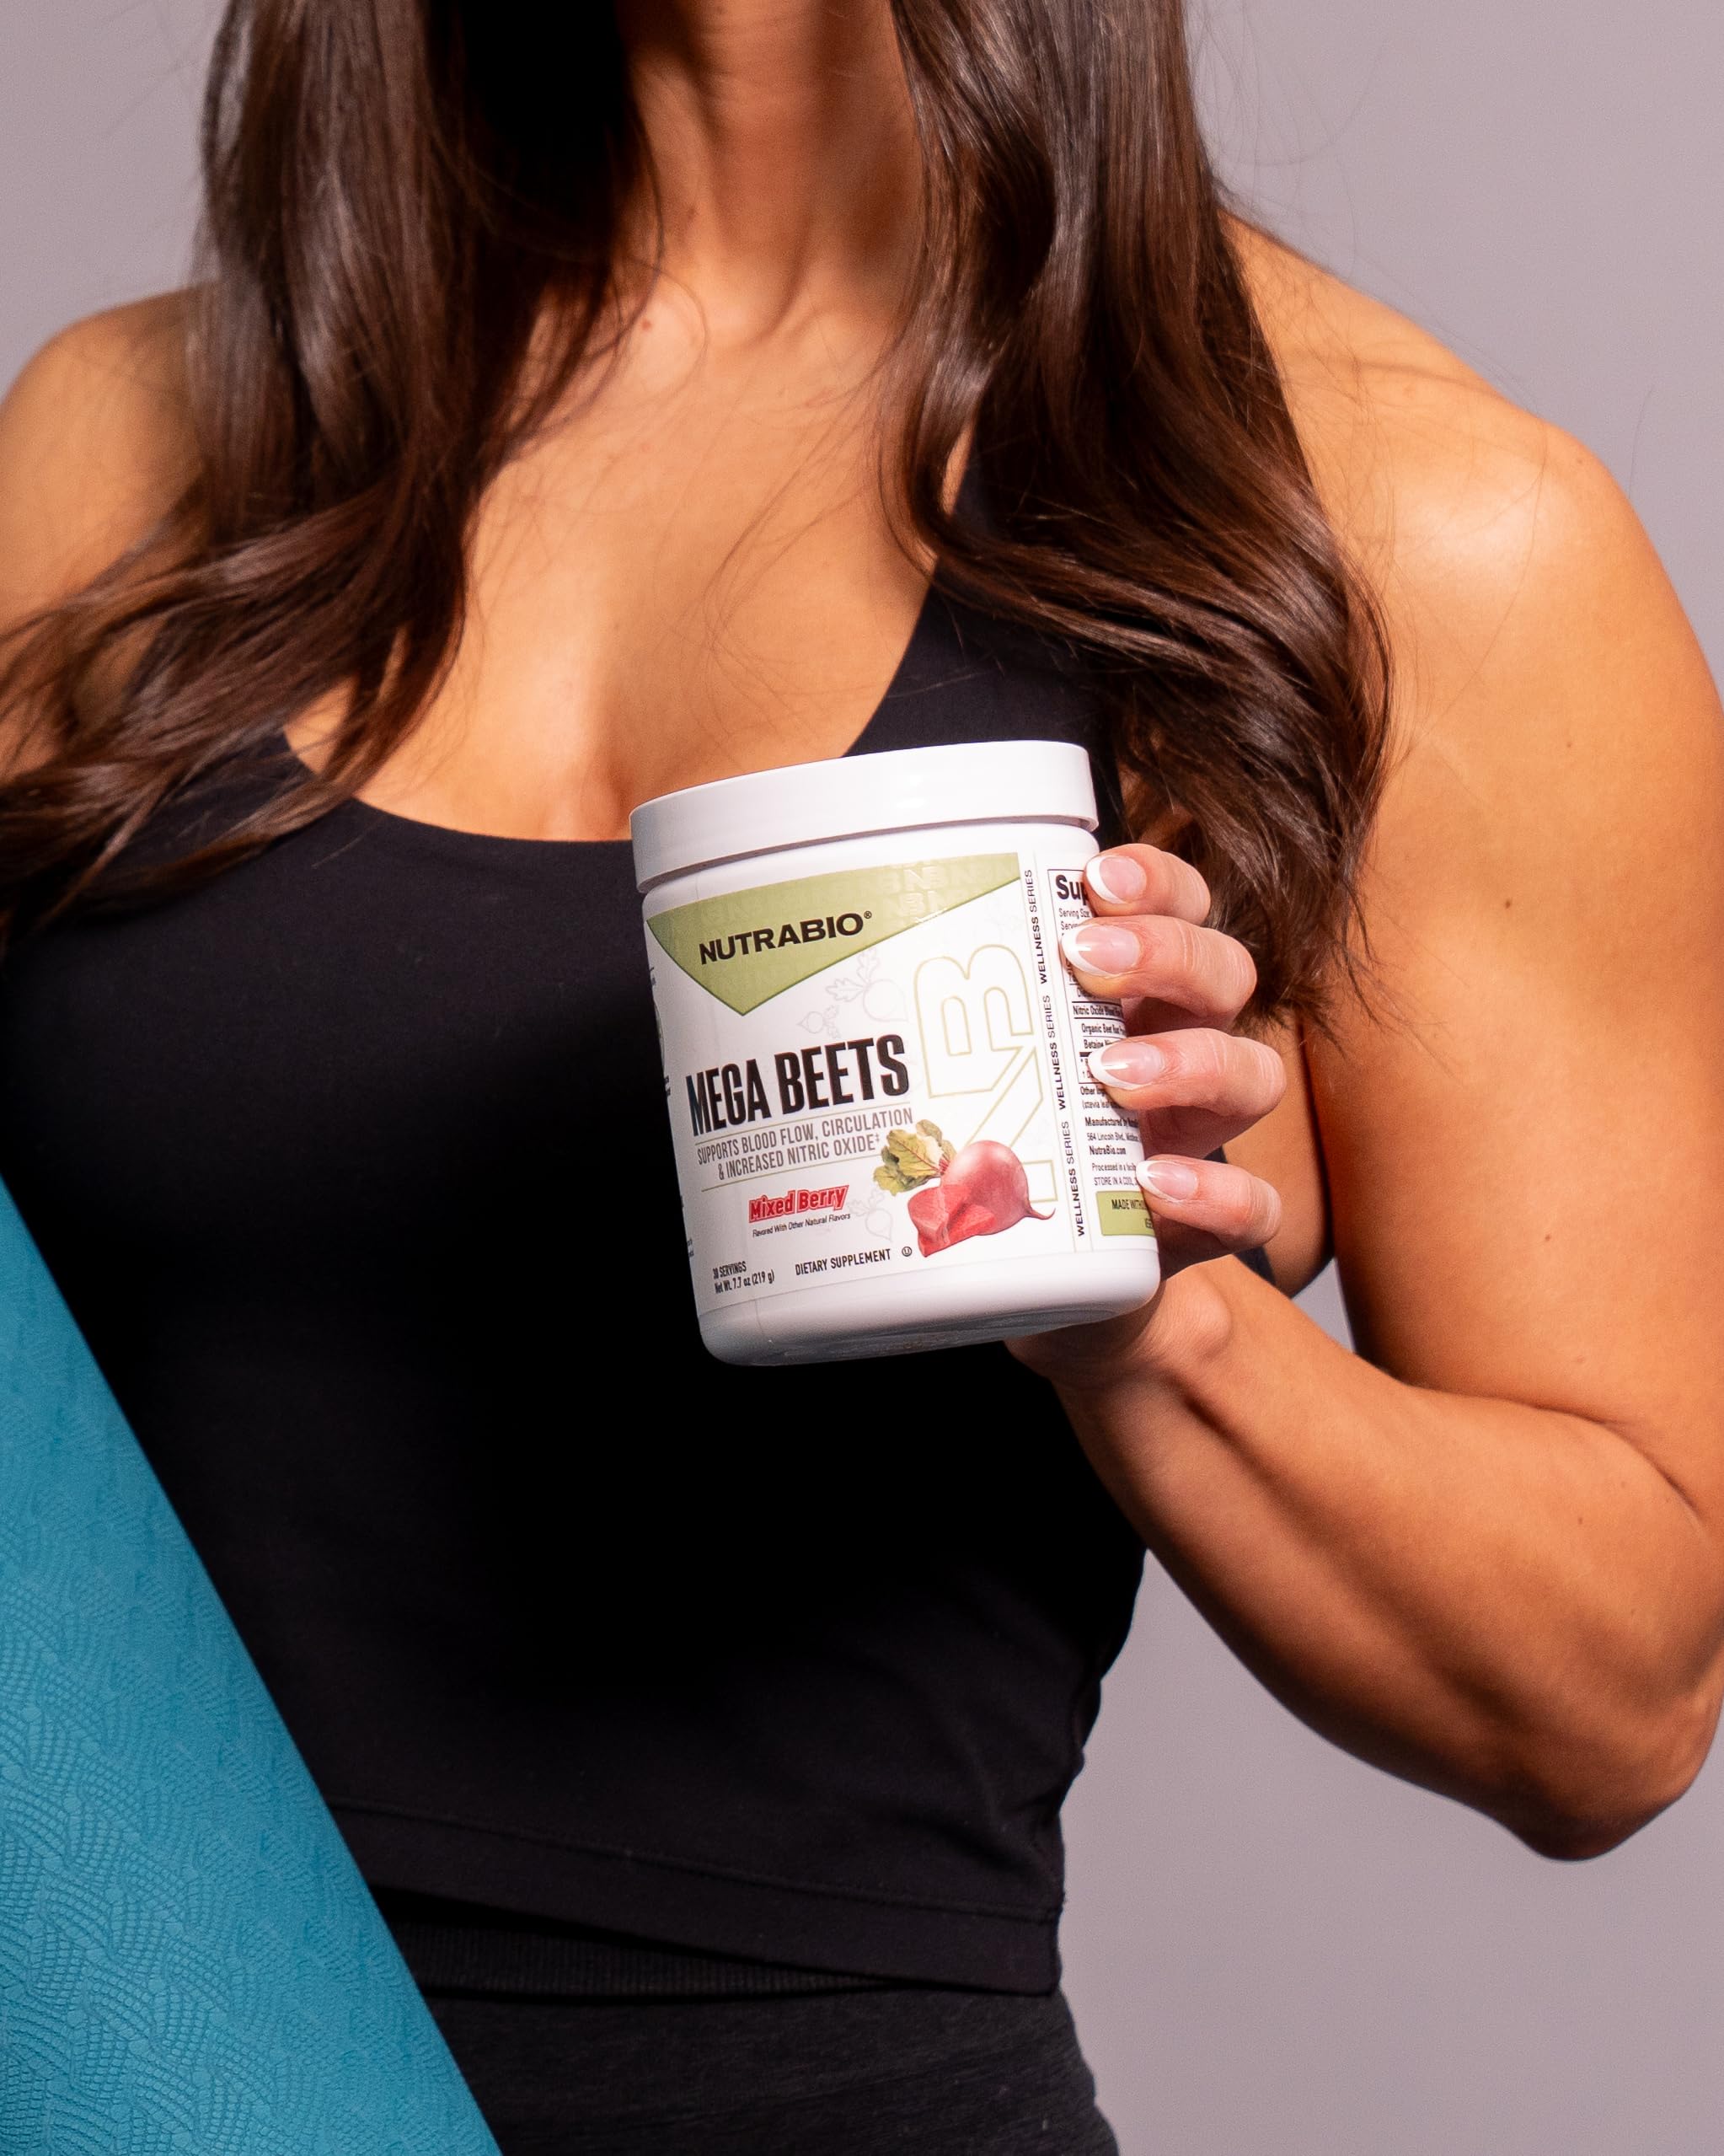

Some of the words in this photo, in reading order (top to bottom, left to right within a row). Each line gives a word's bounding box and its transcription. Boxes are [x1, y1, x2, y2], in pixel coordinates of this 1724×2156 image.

[1025, 870, 1037, 913] SERIES
[1058, 908, 1079, 920] Serving
[1031, 916, 1047, 984] WELLNESS
[1043, 995, 1056, 1038] SERIES
[1073, 1006, 1090, 1016] Nitric
[1081, 1023, 1102, 1035] Organic
[686, 1059, 772, 1136] MEGA
[774, 1034, 909, 1114] BEETS
[1050, 1042, 1066, 1110] WELLNESS
[697, 1140, 740, 1166] SUPPORTS
[742, 1131, 777, 1154] BLOOD
[780, 1124, 818, 1146] FLOW,
[822, 1107, 913, 1137] CIRCULATION
[1062, 1121, 1074, 1165] SERIES
[1089, 1145, 1127, 1156] NutraBio.com
[718, 1163, 725, 1180] &
[725, 1147, 784, 1178] INCREASED
[787, 1141, 830, 1165] NITRIC
[1092, 1163, 1118, 1172] Processed
[1094, 1177, 1111, 1186] STORE
[749, 1190, 795, 1222] Mixed
[796, 1185, 849, 1213] Berry
[1068, 1168, 1085, 1237] WELLNESS
[1111, 1199, 1130, 1210] MADE
[752, 1226, 774, 1237] Flavored
[775, 1224, 787, 1233] With
[788, 1220, 804, 1231] Other
[805, 1215, 827, 1226] Natural
[828, 1213, 851, 1223] Flavors
[719, 1261, 747, 1279] SERVINGS
[795, 1258, 827, 1276] DIETARY
[830, 1248, 891, 1270] SUPPLEMENT
[715, 1281, 723, 1295] Net
[733, 1275, 742, 1290] 7.7
[743, 1275, 751, 1287] oz
[752, 1272, 766, 1286] (219
[768, 1269, 775, 1284] g)
